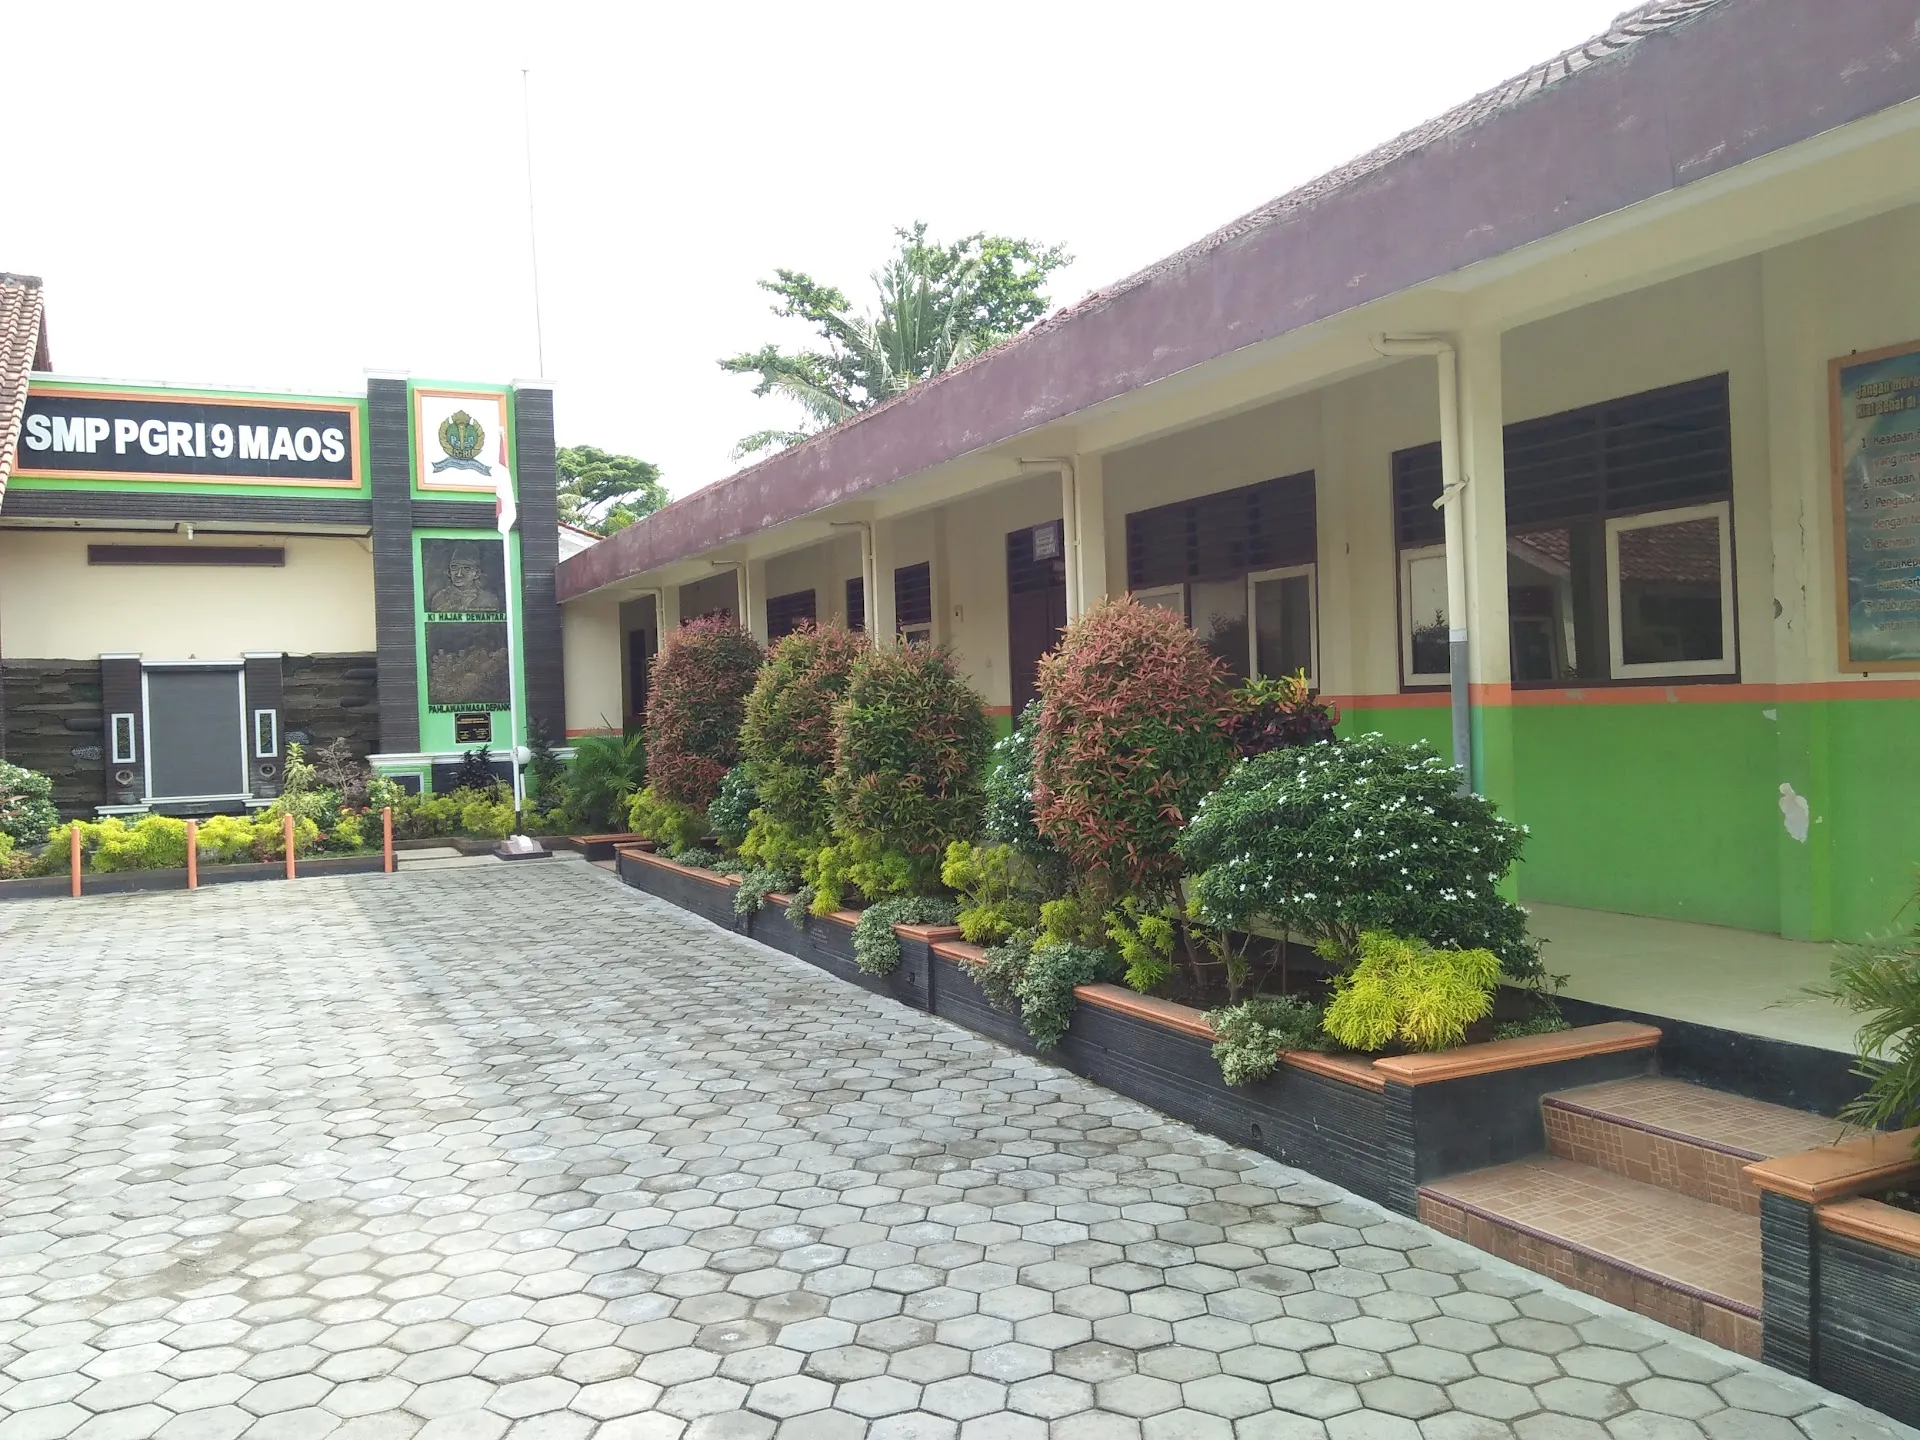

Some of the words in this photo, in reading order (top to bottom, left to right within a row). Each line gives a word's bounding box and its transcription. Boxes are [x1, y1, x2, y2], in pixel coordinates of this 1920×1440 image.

[1856, 380, 1891, 400] Jangan
[1876, 396, 1905, 415] Sehat
[26, 414, 110, 453] SMP
[115, 418, 206, 458] PGRI
[212, 423, 233, 458] 9
[239, 425, 345, 463] MAOS
[1873, 432, 1914, 446] Keadaan
[1874, 455, 1898, 468] yang
[1875, 474, 1915, 488] Keadaan
[1872, 517, 1908, 530] dengan
[428, 613, 436, 621] KI
[439, 613, 463, 621] HAJAR
[465, 703, 485, 713] MASA
